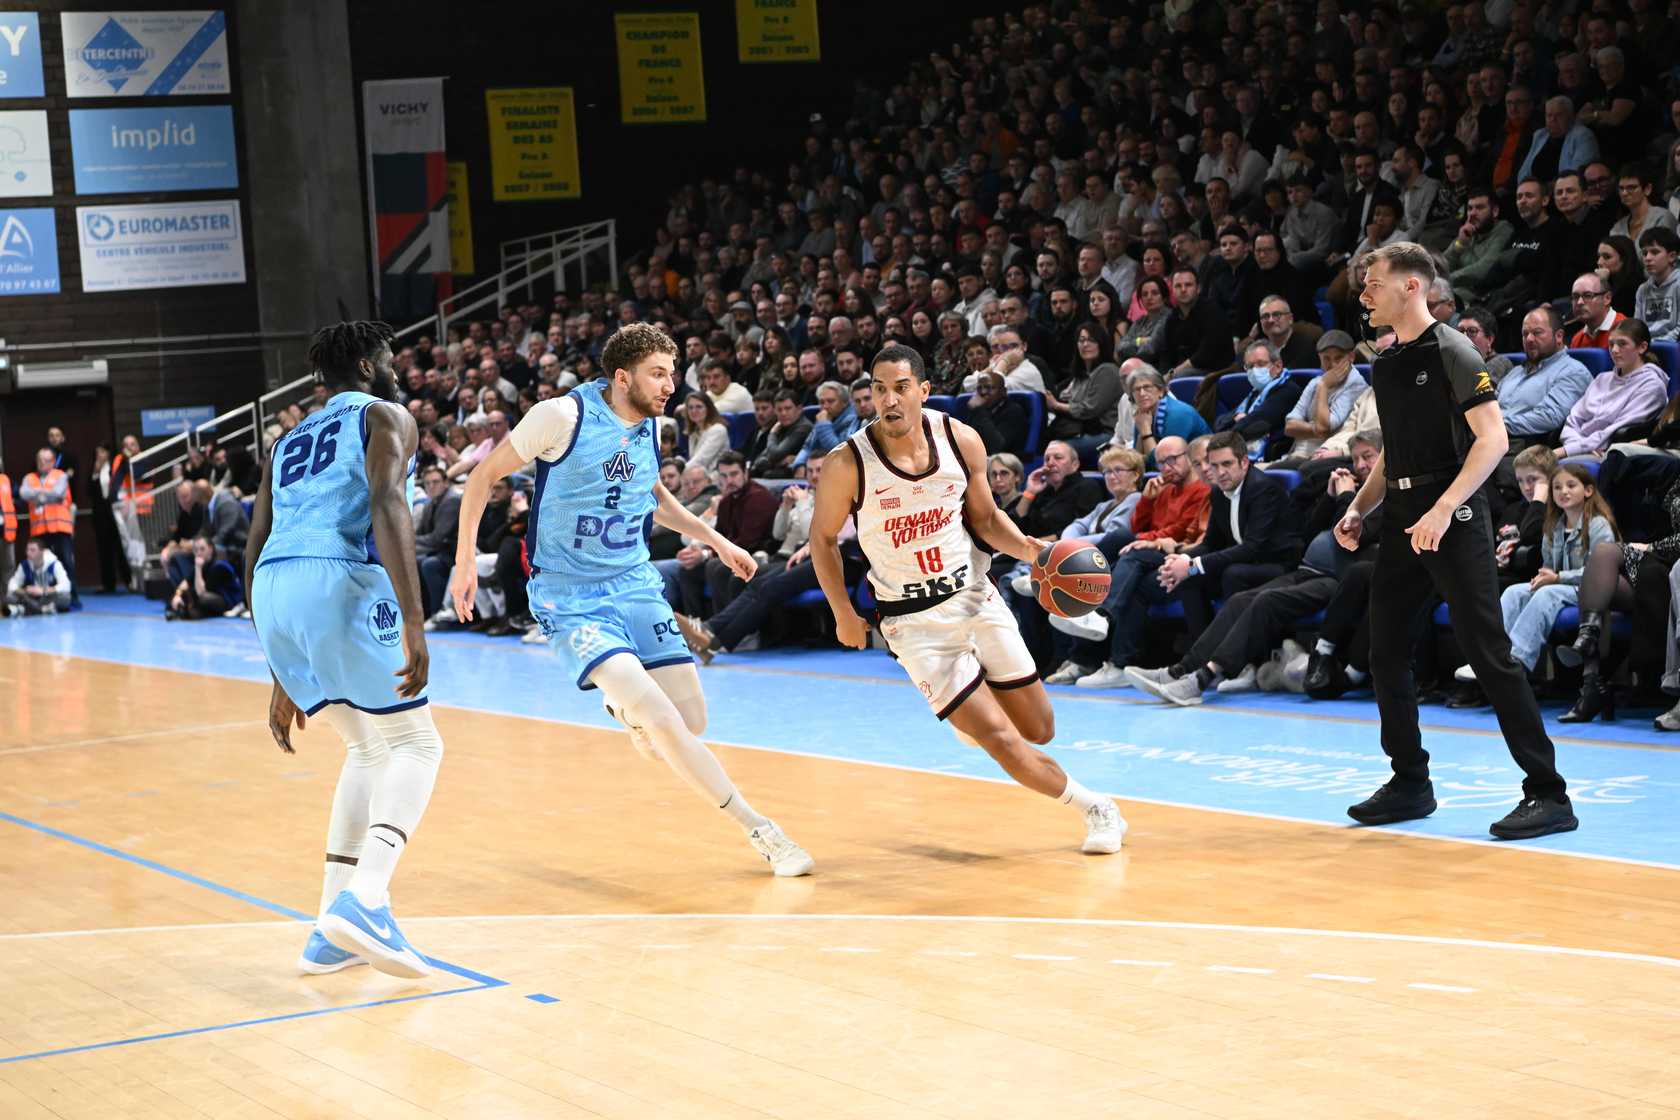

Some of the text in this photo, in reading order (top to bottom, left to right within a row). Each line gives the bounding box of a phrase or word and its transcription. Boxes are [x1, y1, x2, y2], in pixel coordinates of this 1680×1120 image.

[378, 102, 430, 116] VICHY
[111, 120, 196, 150] implid
[118, 213, 231, 235] EUROMASTER
[280, 420, 342, 489] 26
[604, 485, 622, 510] 2
[884, 506, 944, 533] DENAIN
[913, 546, 944, 575] 18
[901, 564, 969, 599] SKF
